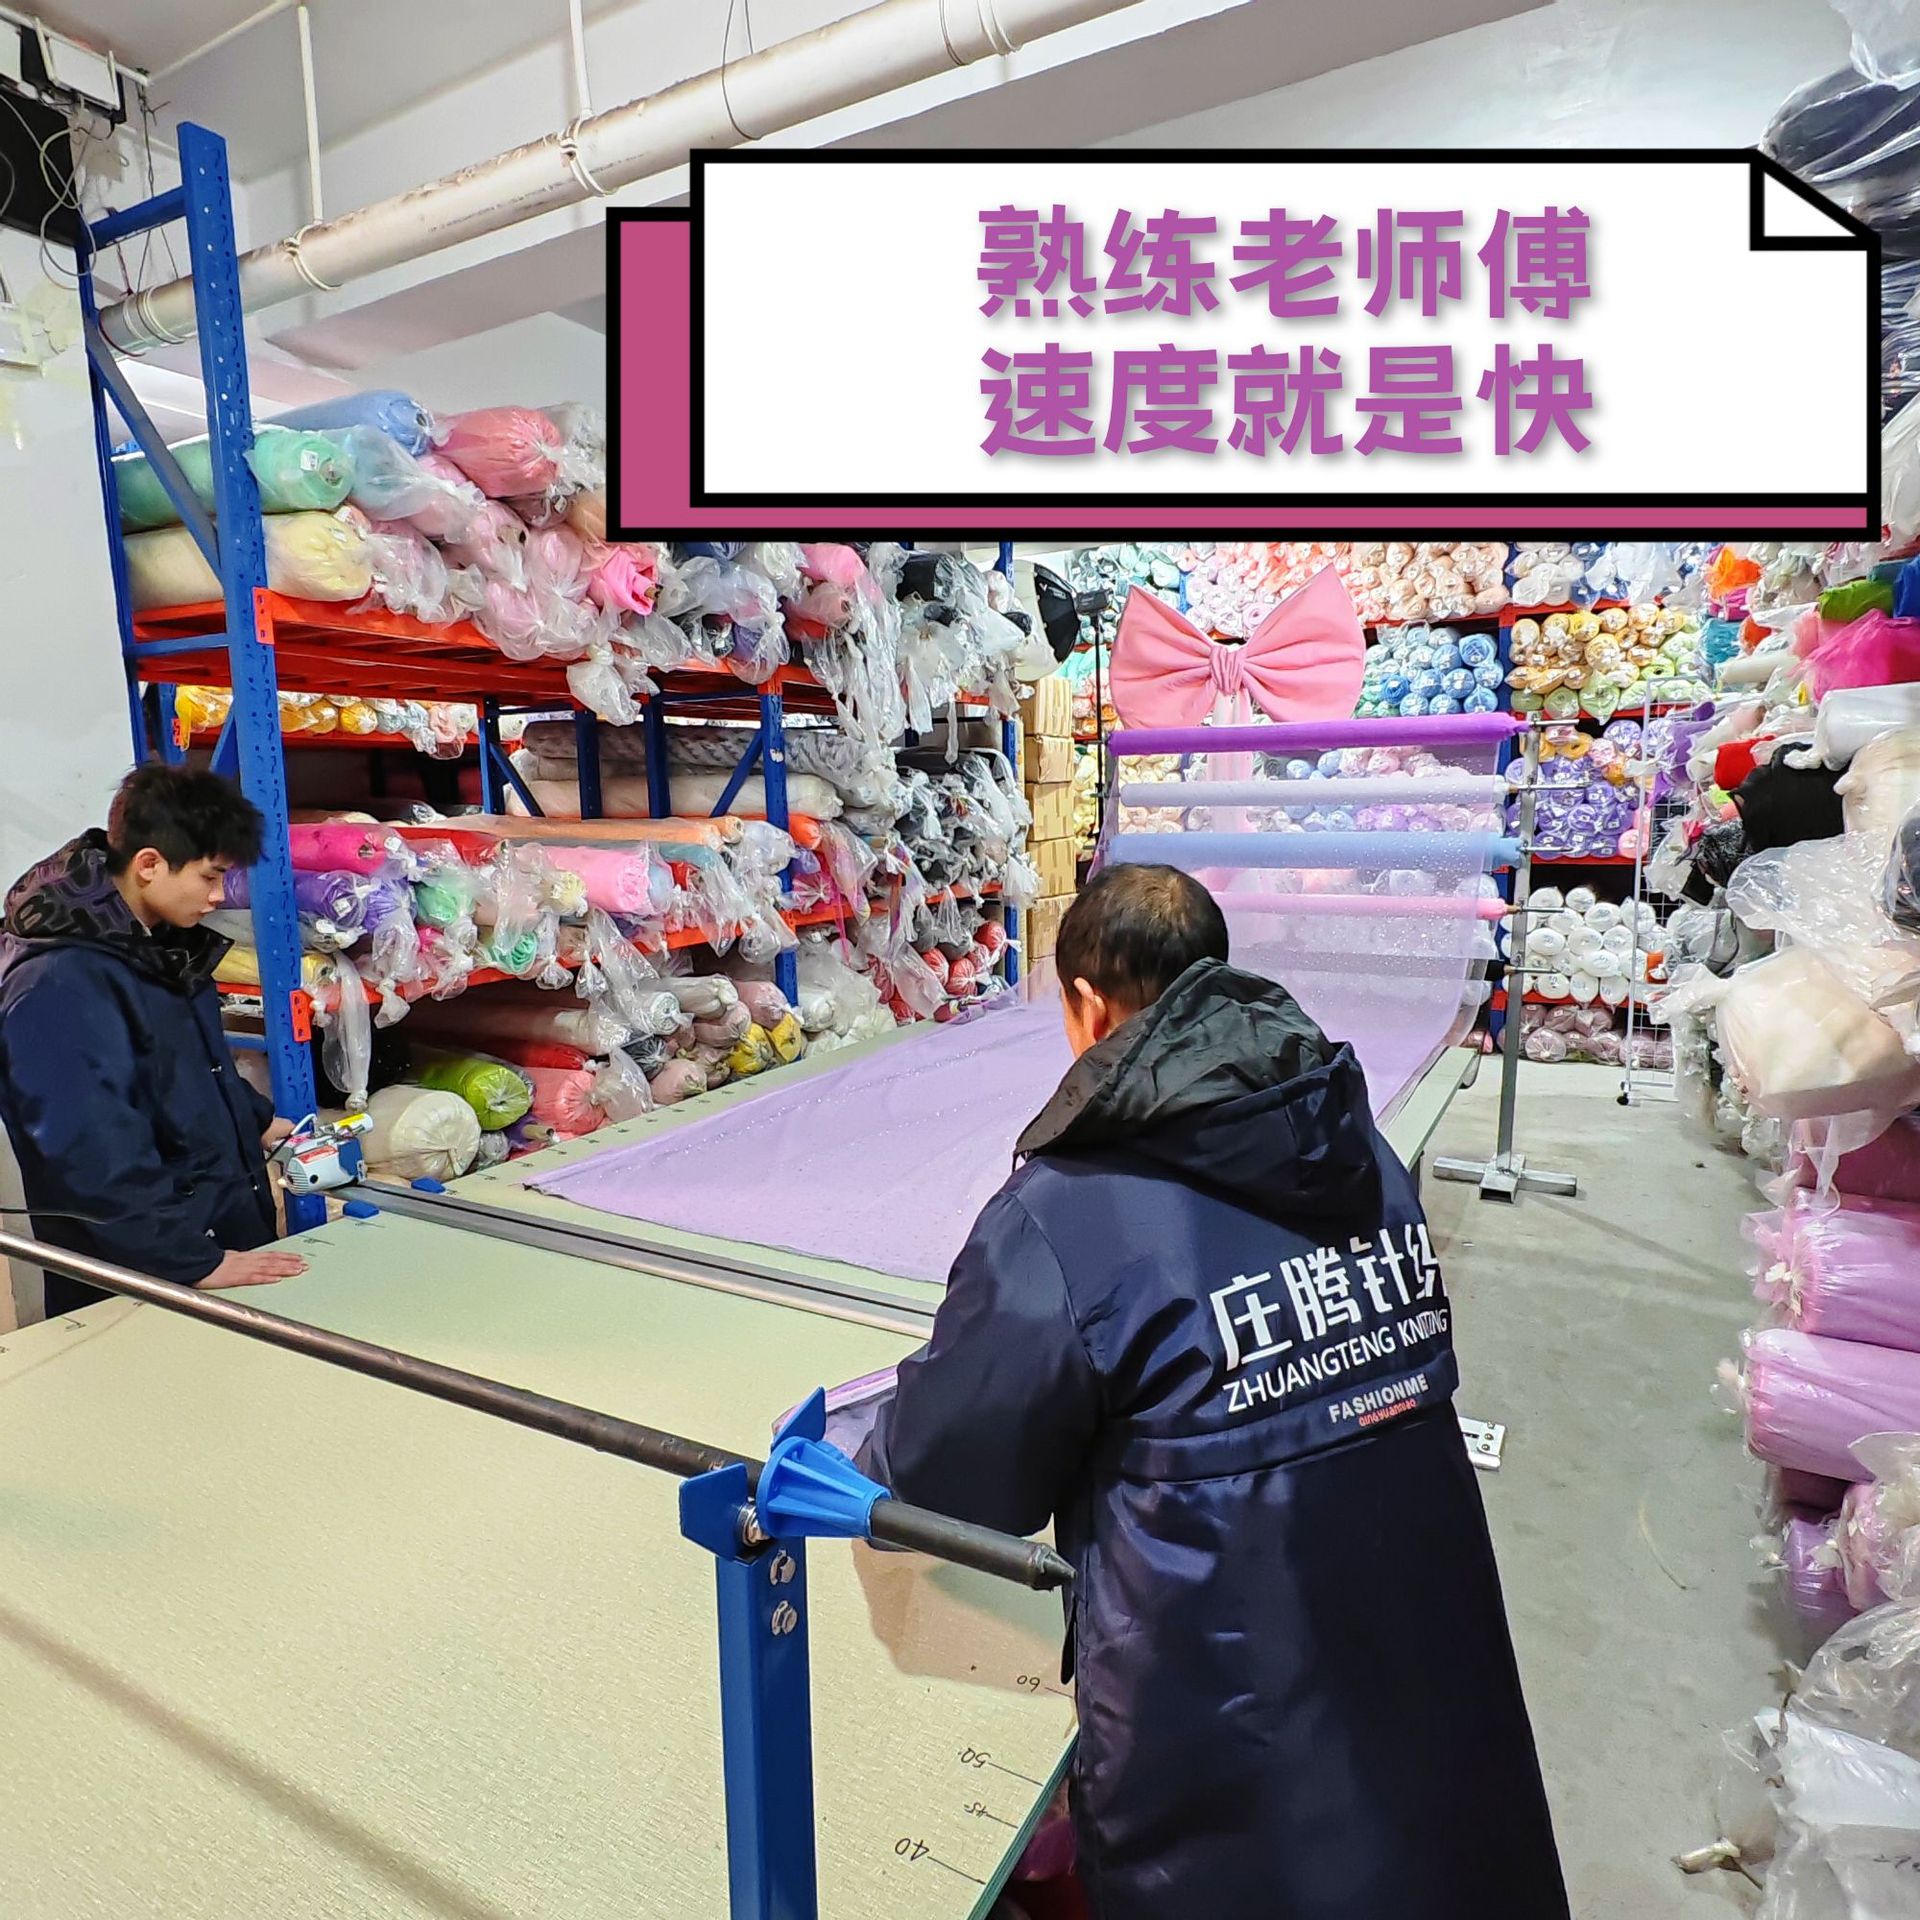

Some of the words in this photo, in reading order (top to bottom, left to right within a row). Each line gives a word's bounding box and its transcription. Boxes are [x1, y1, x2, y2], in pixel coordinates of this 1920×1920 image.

[1222, 1325, 1397, 1414] ZHUANGTENG
[1328, 1373, 1430, 1424] FASHIONME
[894, 1837, 930, 1862] 40
